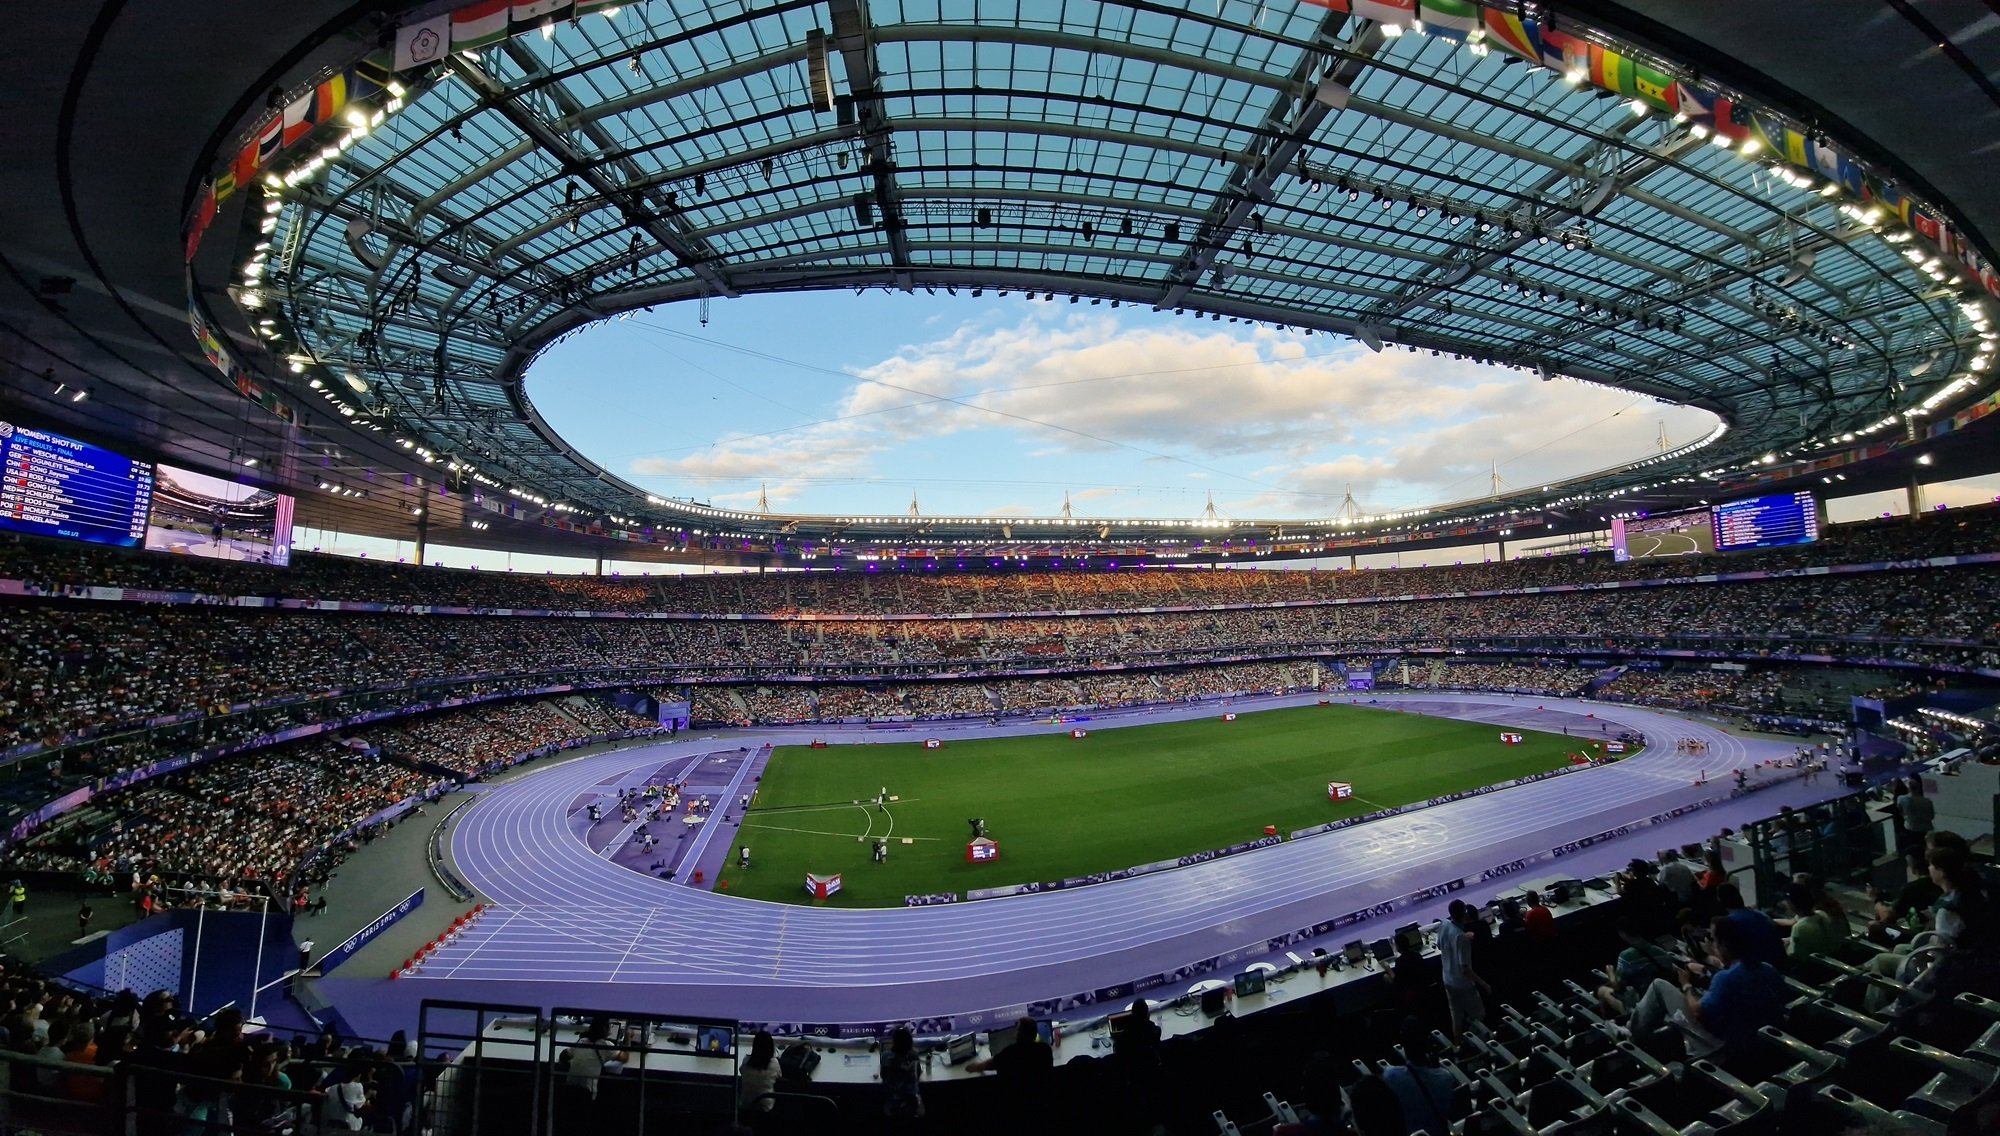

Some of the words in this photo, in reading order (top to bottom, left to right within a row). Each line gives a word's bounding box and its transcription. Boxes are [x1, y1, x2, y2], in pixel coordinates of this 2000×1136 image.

[15, 436, 29, 444] LIVE
[29, 440, 52, 451] RESULTS
[57, 448, 74, 457] FINAL
[16, 426, 51, 442] WOMEN'S
[51, 437, 70, 447] SHOT
[70, 442, 84, 451] PUT
[172, 758, 188, 768] PARIS
[361, 922, 380, 940] PARIS
[380, 912, 396, 926] 2024
